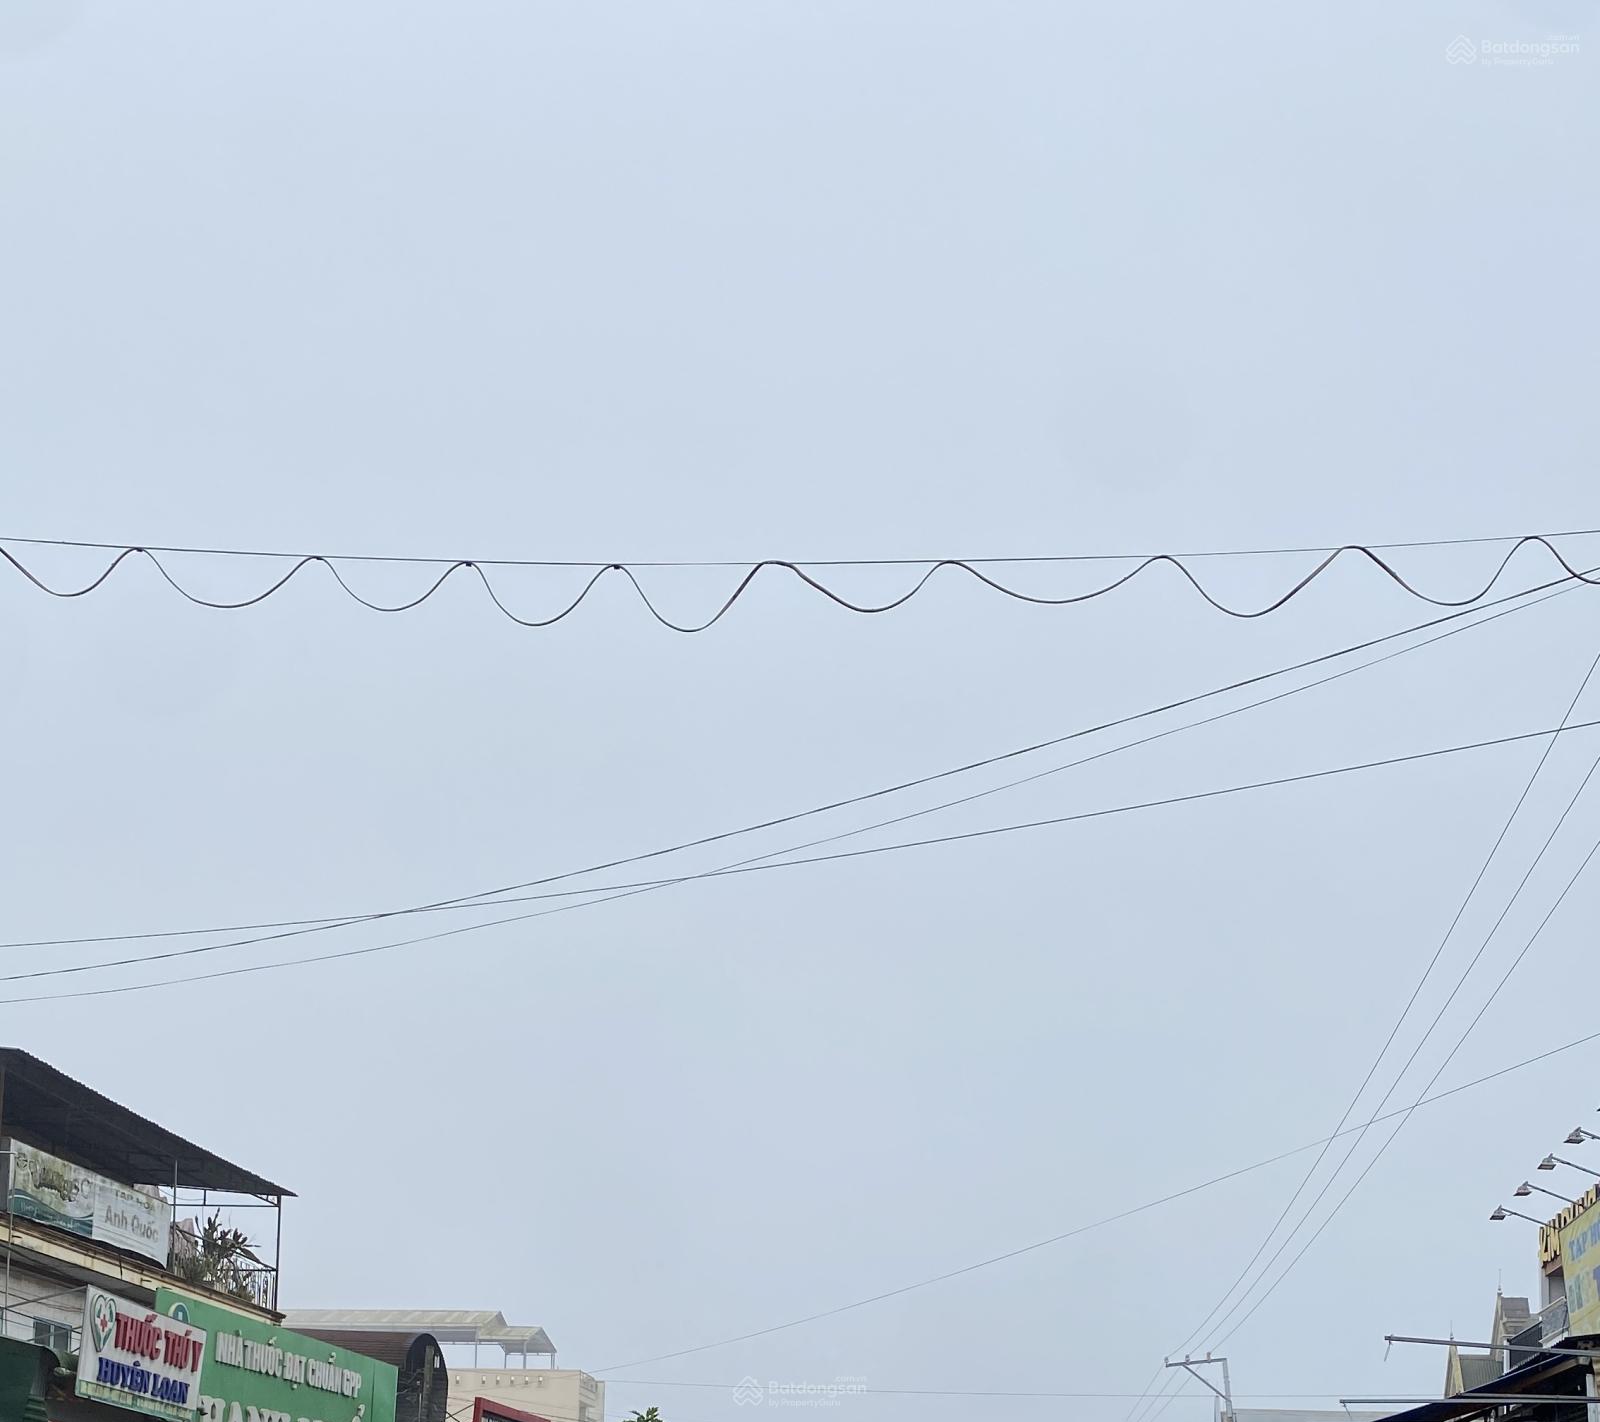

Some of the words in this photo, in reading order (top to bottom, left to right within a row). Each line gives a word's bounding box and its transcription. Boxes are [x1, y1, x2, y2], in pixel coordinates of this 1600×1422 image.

[114, 1312, 162, 1360] THUỐC
[215, 1329, 244, 1368] NHÀ
[243, 1336, 284, 1377] THUỐC
[283, 1351, 307, 1390] ĐẠT
[307, 1351, 343, 1395] CHUẨN
[341, 1368, 362, 1399] GPP
[151, 1373, 190, 1404] LOAN
